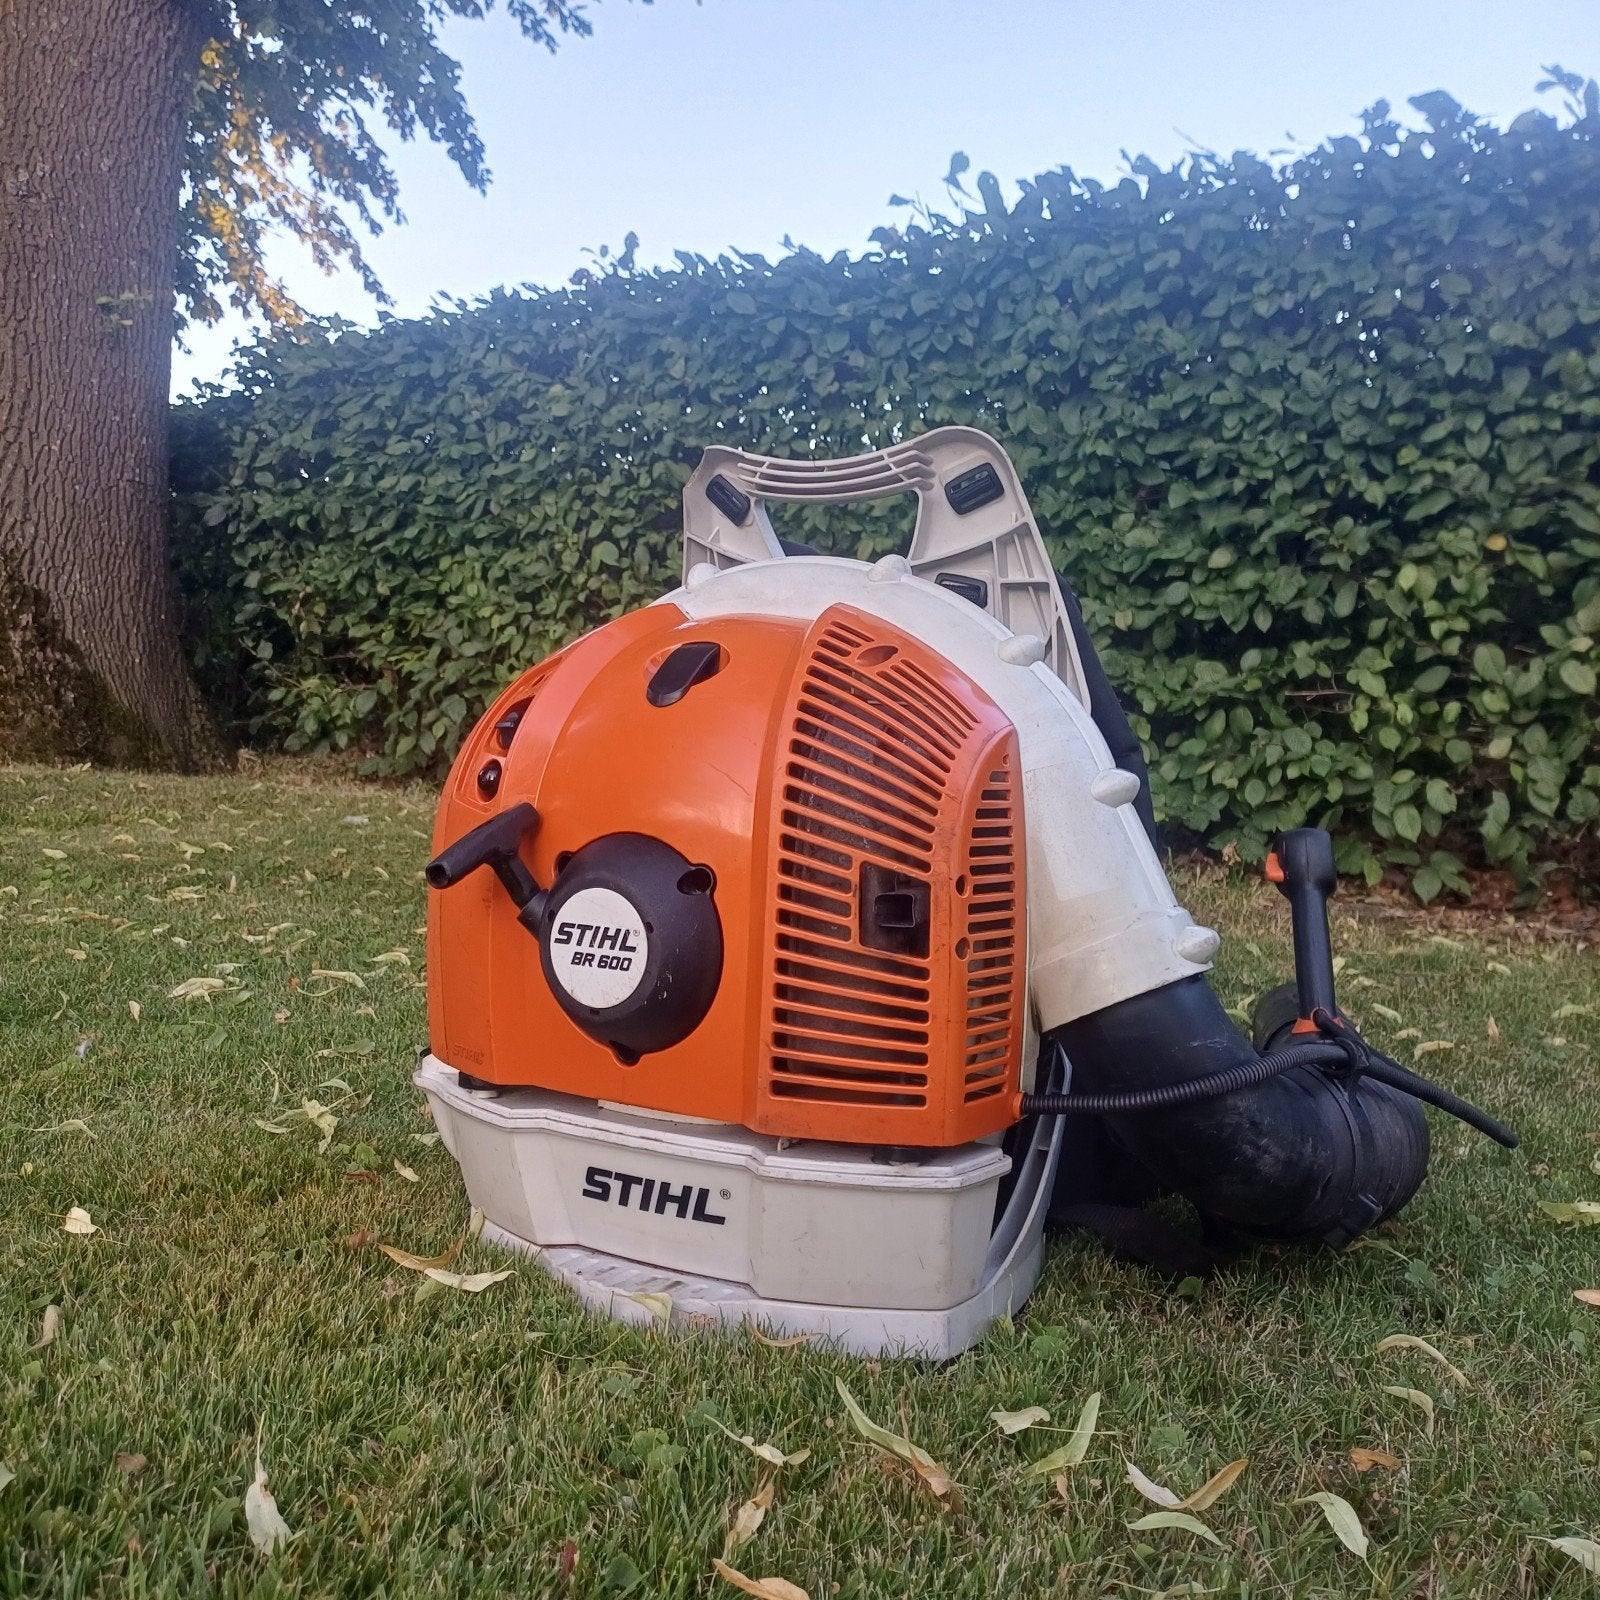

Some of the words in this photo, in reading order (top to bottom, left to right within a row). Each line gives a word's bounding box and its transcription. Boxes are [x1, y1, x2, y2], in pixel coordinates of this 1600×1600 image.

[554, 922, 637, 953] STIHL
[571, 951, 595, 968] BR
[597, 956, 632, 972] 600
[582, 1166, 726, 1226] STIHL
